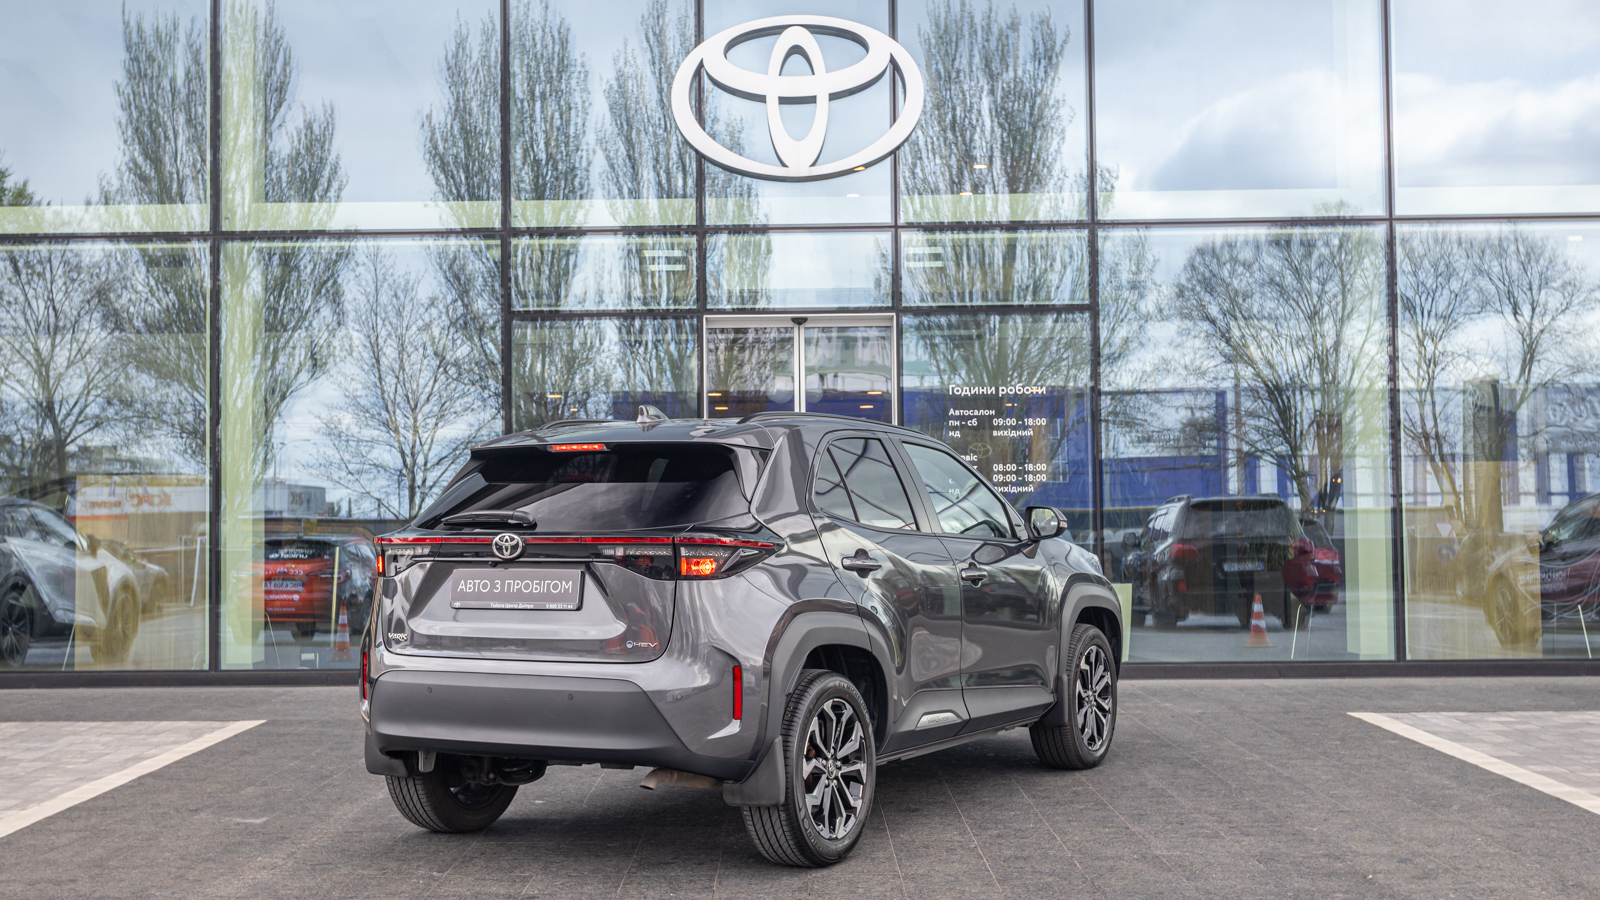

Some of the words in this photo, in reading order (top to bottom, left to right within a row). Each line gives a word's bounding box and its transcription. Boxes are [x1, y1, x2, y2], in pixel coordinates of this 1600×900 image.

[948, 384, 996, 397] Години
[998, 383, 1046, 397] роботи
[948, 408, 995, 416] Автосалон
[967, 418, 978, 426] сб
[992, 418, 1017, 426] 09:00
[1023, 418, 1047, 426] 18:00
[948, 430, 961, 438] нд
[992, 428, 1034, 438] вихідний
[992, 463, 1017, 472] 08:00
[1023, 463, 1047, 472] 18:00
[992, 473, 1017, 482] 09:00
[1023, 473, 1047, 482] 18:00
[457, 579, 491, 593] АВТО
[493, 579, 502, 593] З
[504, 580, 573, 594] ПРОБІГОМ
